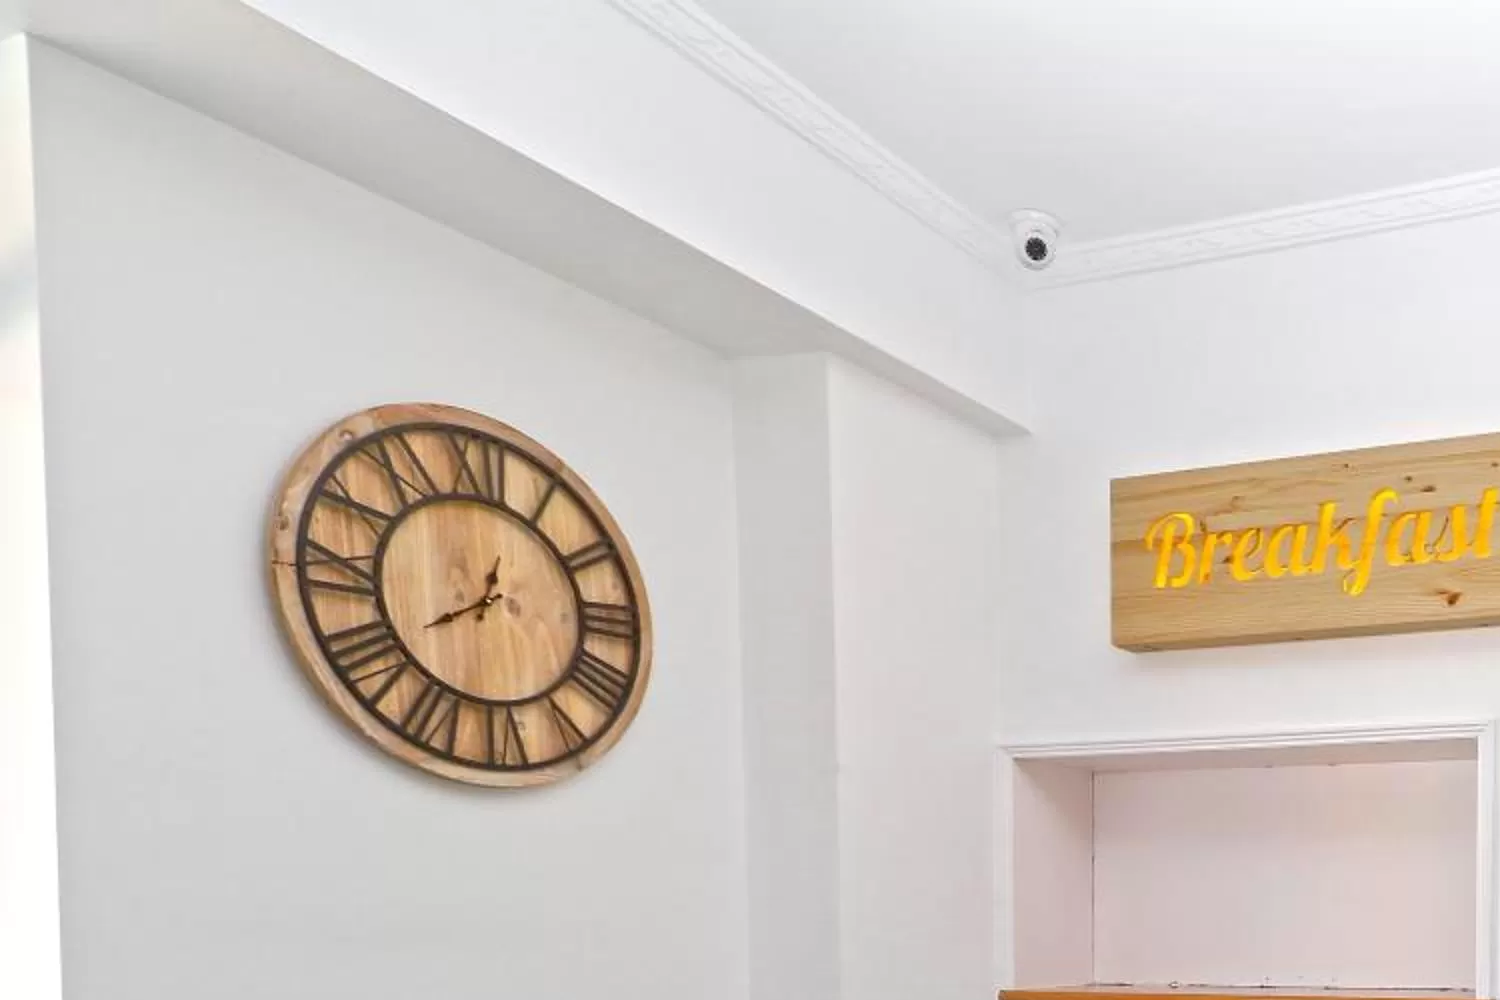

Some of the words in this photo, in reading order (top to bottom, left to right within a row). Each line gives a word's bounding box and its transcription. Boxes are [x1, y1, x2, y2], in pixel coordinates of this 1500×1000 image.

[359, 431, 440, 506] XI
[450, 431, 507, 503] XII
[319, 474, 394, 538] X
[302, 538, 378, 598] IX
[563, 535, 617, 571] II
[1144, 486, 1500, 596] Breakfast
[580, 600, 636, 639] III
[323, 621, 407, 708] VIII
[400, 679, 460, 757] VII
[484, 702, 530, 768] VI
[545, 694, 589, 751] V
